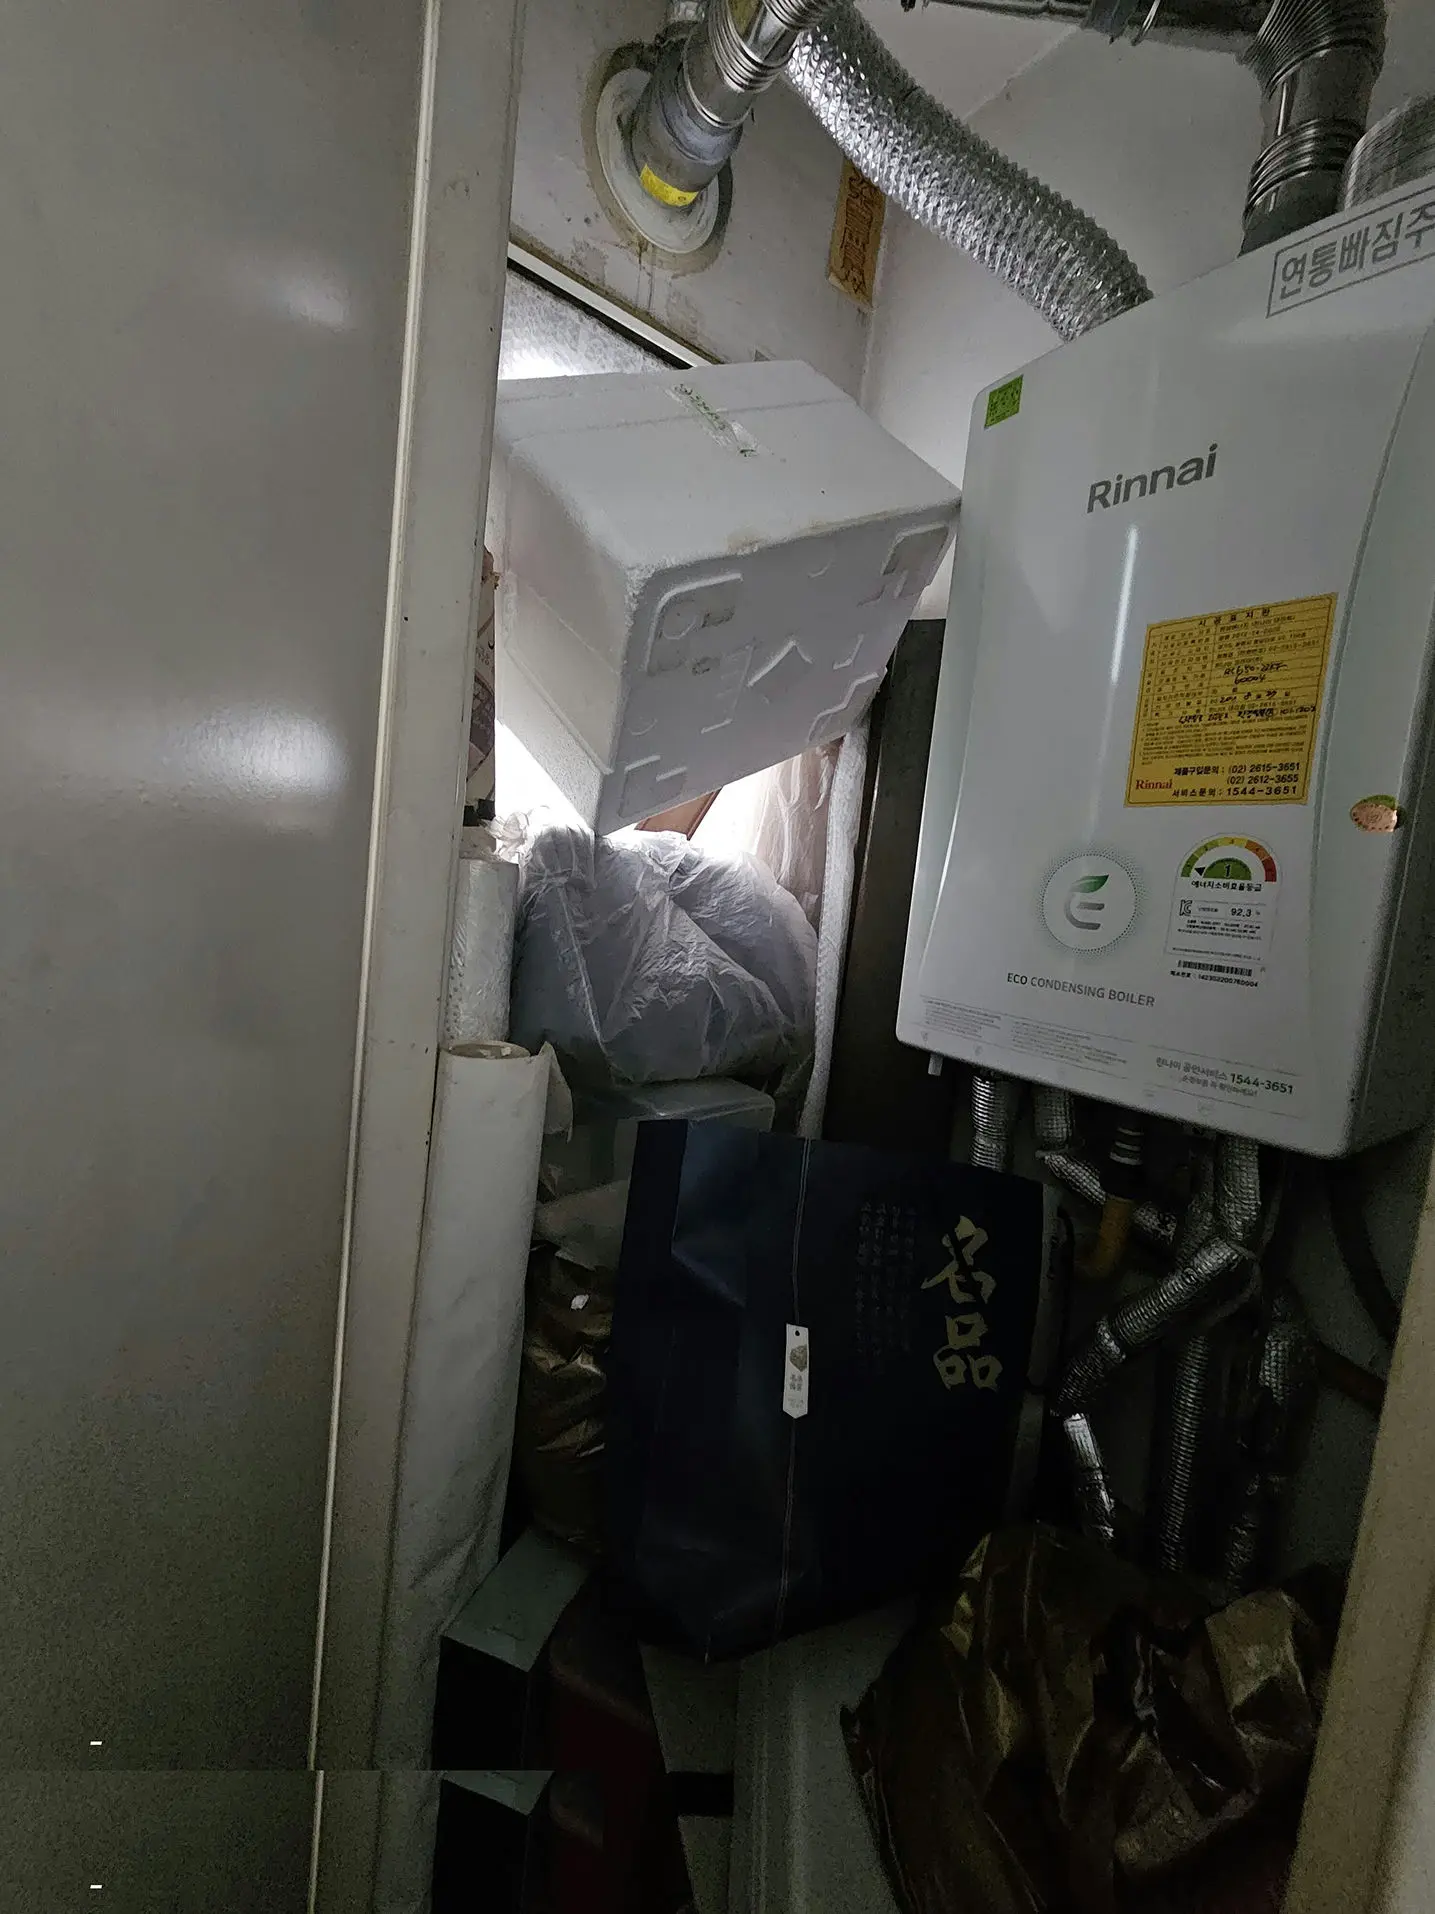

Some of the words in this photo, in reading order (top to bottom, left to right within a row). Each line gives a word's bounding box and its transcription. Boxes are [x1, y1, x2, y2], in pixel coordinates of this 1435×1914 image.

[1086, 444, 1218, 513] Rinnai
[1250, 762, 1300, 773] 2615-3651
[1135, 778, 1173, 790] Rinnai
[1247, 773, 1299, 785] 2612-3655
[1227, 785, 1297, 797] 1544-3651
[1230, 907, 1252, 918] 92.3
[1007, 972, 1028, 985] ECO
[1030, 976, 1105, 999] CONDENSING
[1108, 989, 1156, 1008] BOILER
[1230, 1073, 1294, 1095] 1544-3651
